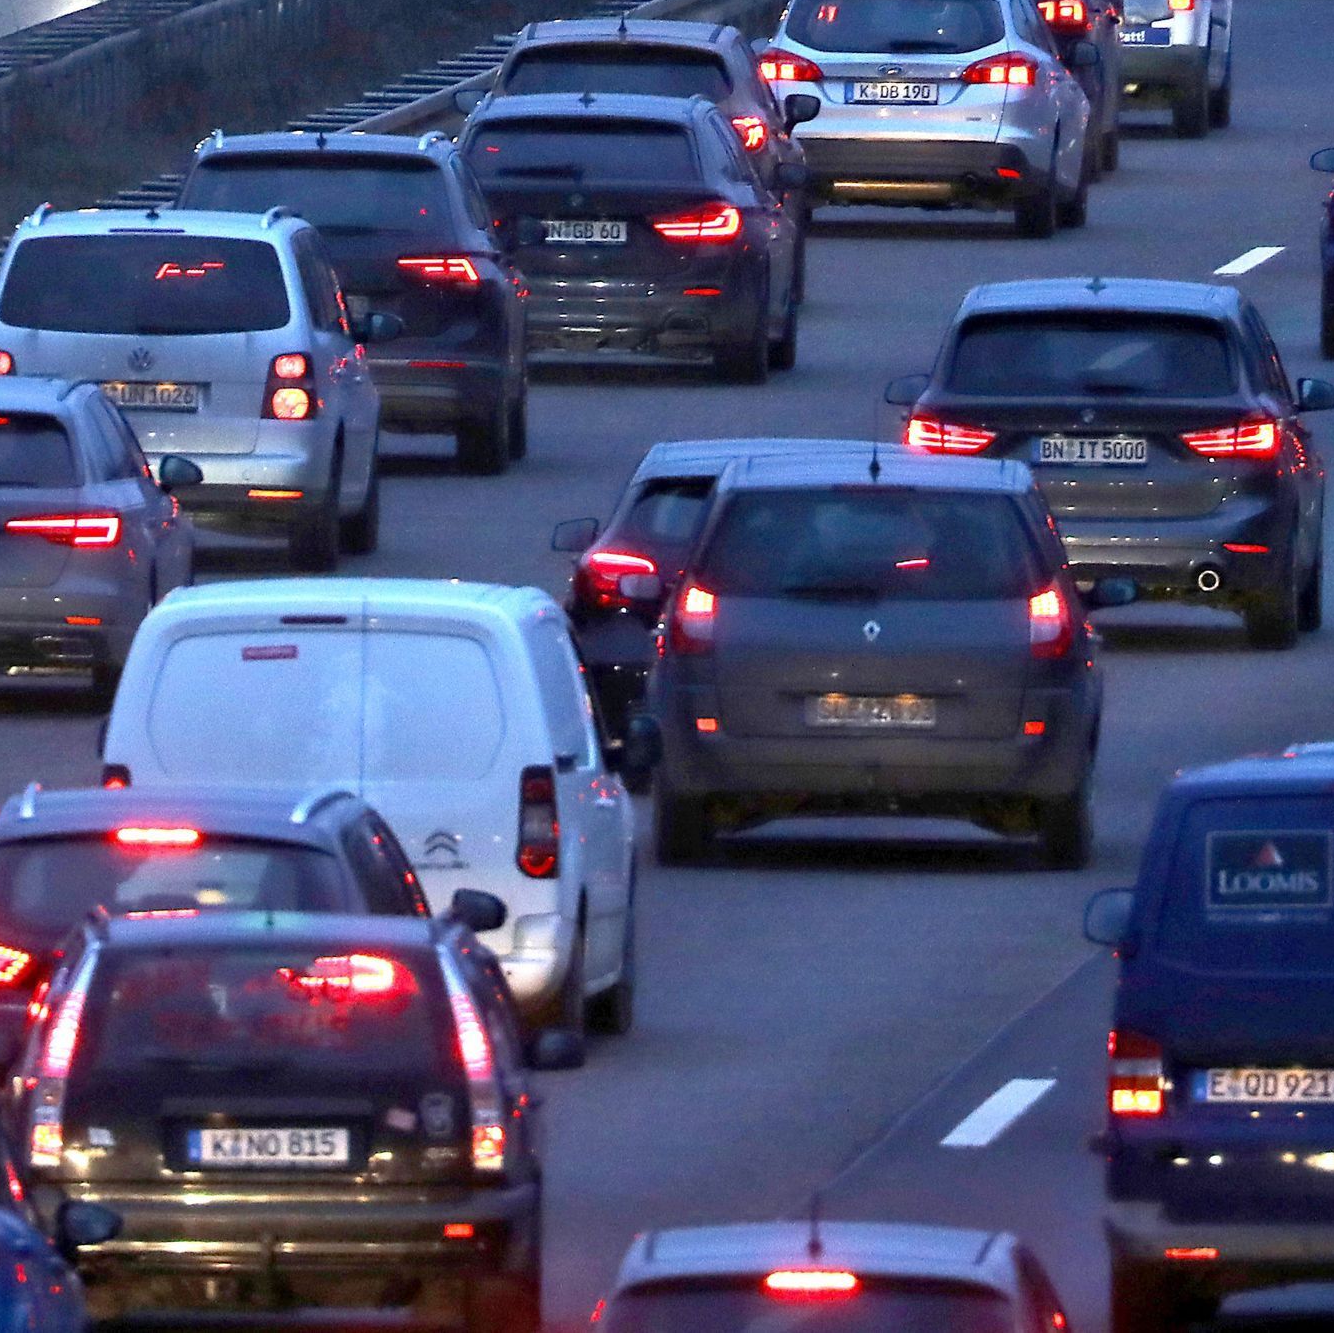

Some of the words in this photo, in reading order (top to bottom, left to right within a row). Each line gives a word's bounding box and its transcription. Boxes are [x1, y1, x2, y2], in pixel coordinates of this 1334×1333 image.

[903, 85, 931, 100] 190
[1042, 441, 1064, 459] BN
[1076, 441, 1099, 460] IT
[1101, 440, 1145, 460] 5000
[1218, 869, 1319, 895] LOOMIS
[1210, 1072, 1228, 1098] E
[287, 1132, 337, 1157] 815
